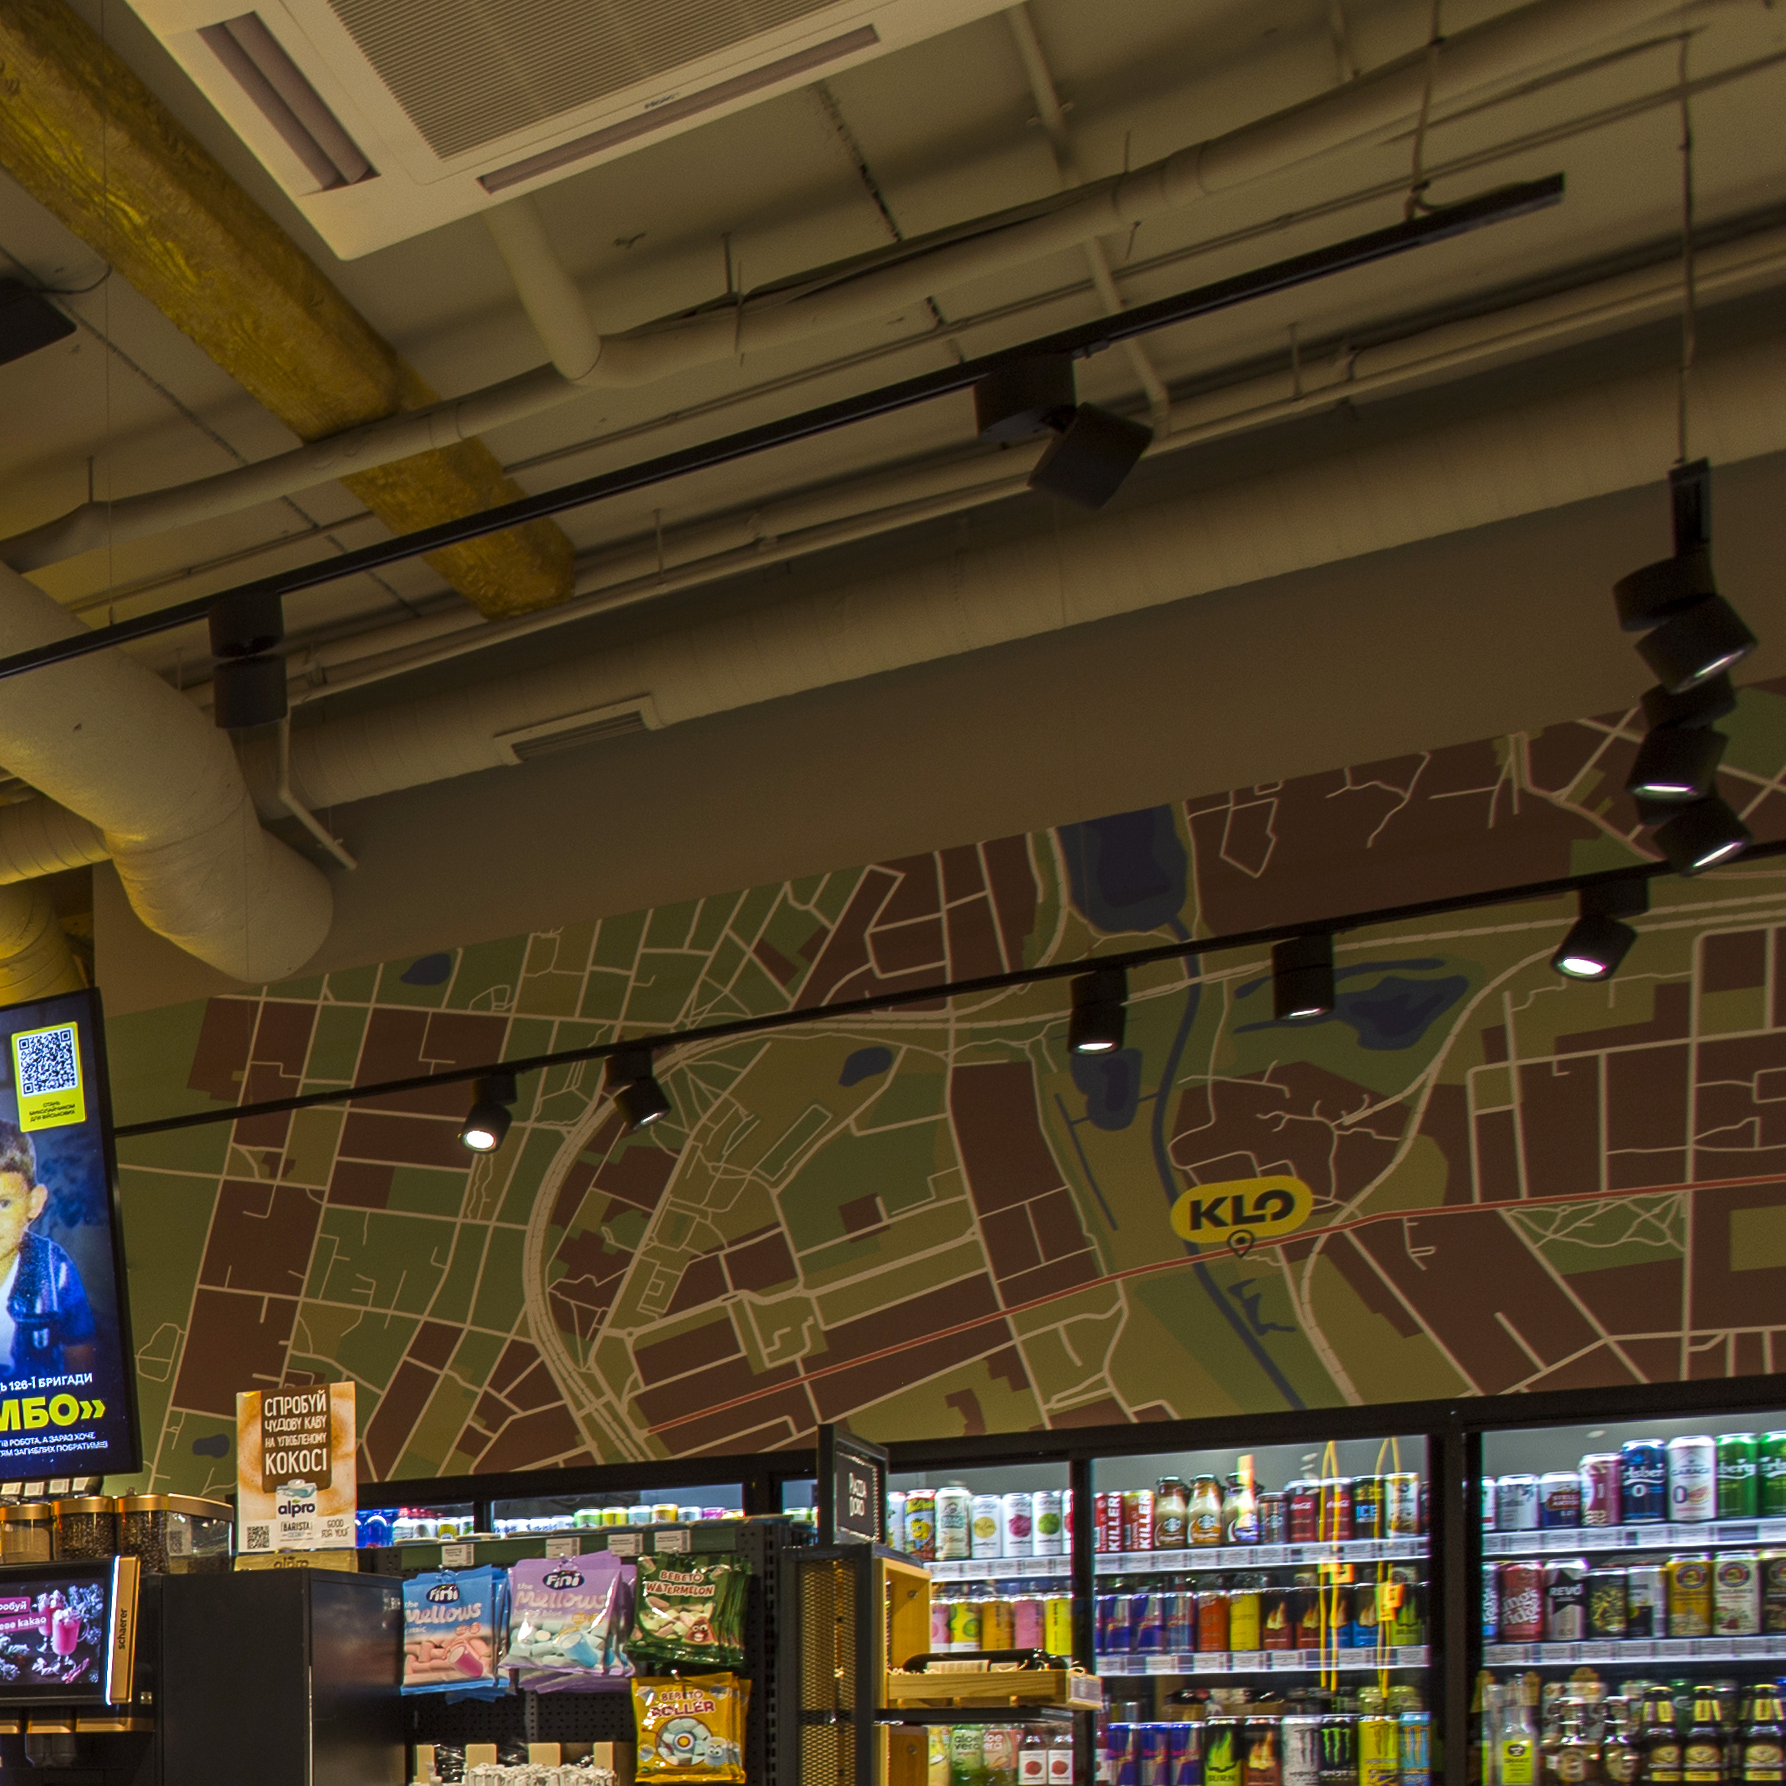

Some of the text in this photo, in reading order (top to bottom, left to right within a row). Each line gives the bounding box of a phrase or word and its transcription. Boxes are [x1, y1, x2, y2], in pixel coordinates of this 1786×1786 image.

[1190, 1189, 1295, 1231] KLO
[37, 1372, 94, 1388] БРИГАДИ
[264, 1389, 327, 1417] СПРОБУЙ
[264, 1415, 327, 1433] ЧУДОВУ КАВУ
[265, 1437, 275, 1448] НА
[265, 1448, 327, 1476] КОКОСІ
[278, 1500, 316, 1518] alpro
[1107, 1493, 1121, 1553] KILLER
[1138, 1494, 1152, 1551] KILLER
[545, 1573, 581, 1589] Fini
[660, 1570, 704, 1584] BEBETO
[645, 1582, 716, 1597] WATERMELON
[17, 1615, 47, 1628] какао
[116, 1607, 129, 1650] schaerer
[650, 1700, 716, 1718] ROLLER
[953, 1734, 980, 1744] aloe
